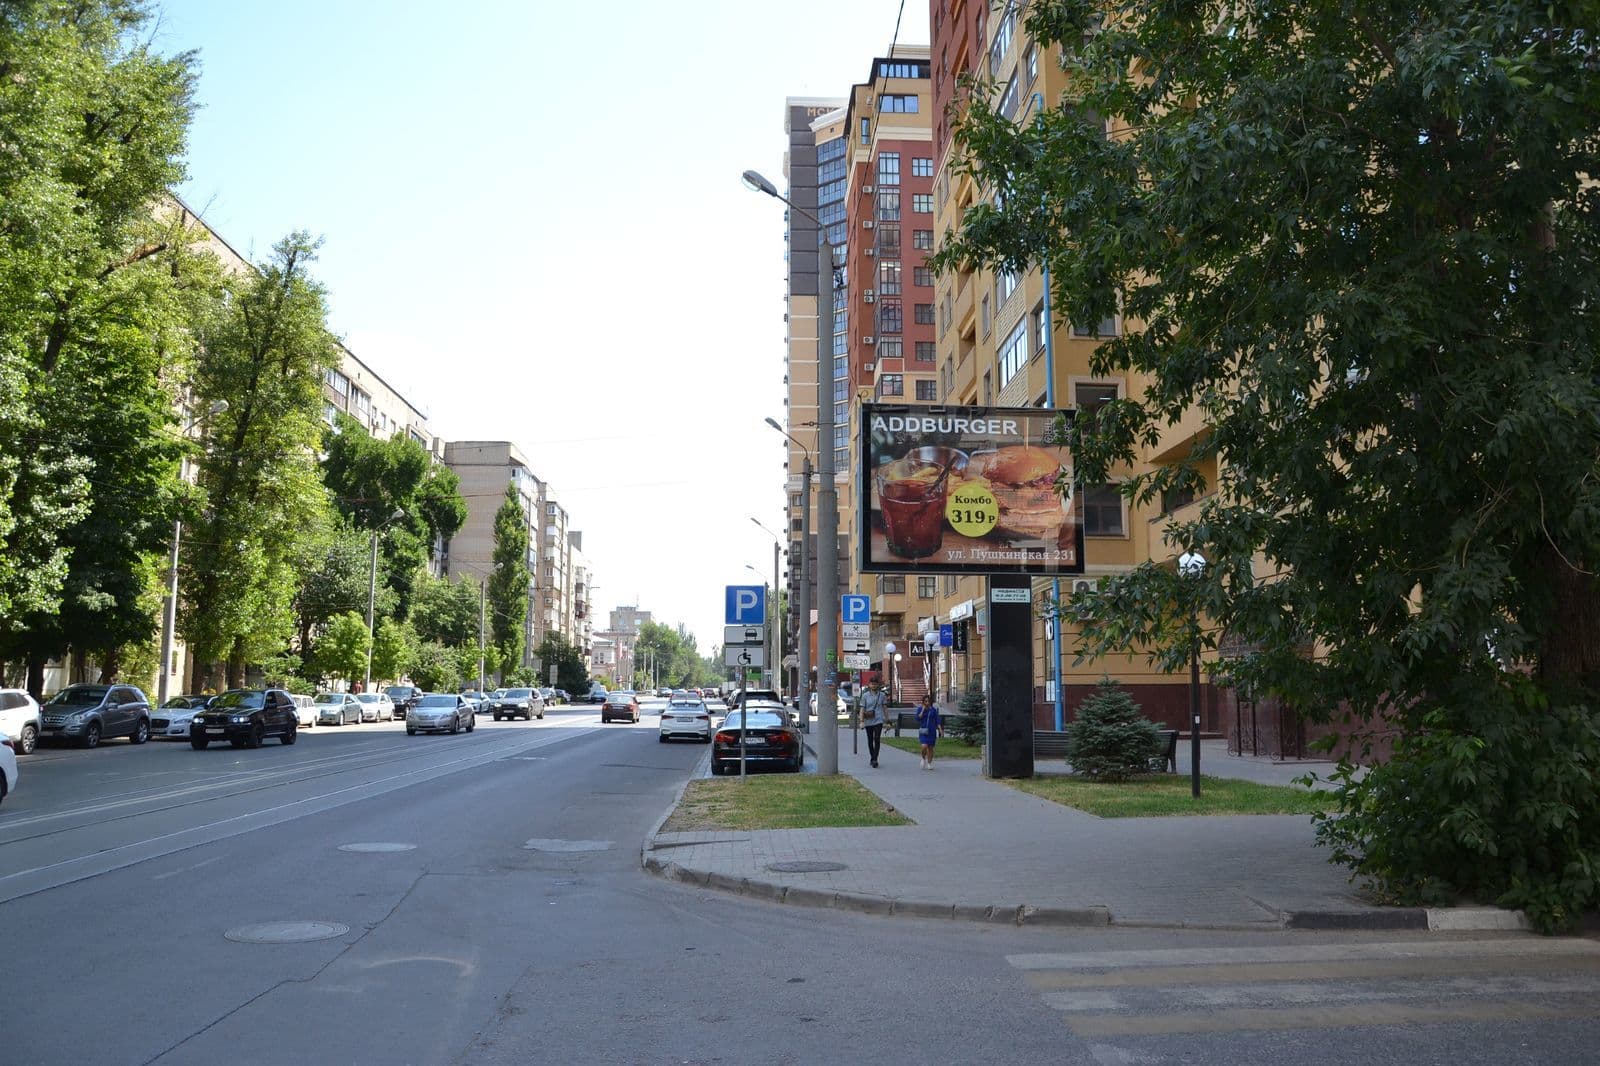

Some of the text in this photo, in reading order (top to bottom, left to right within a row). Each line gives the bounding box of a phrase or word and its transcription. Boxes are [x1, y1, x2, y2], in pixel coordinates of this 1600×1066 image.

[872, 416, 1018, 435] ADDBURGER
[955, 495, 992, 505] Комбо
[952, 510, 986, 524] 319
[947, 549, 1075, 561] ул. Пушкинская 231
[735, 589, 758, 620] P
[849, 598, 866, 620] P
